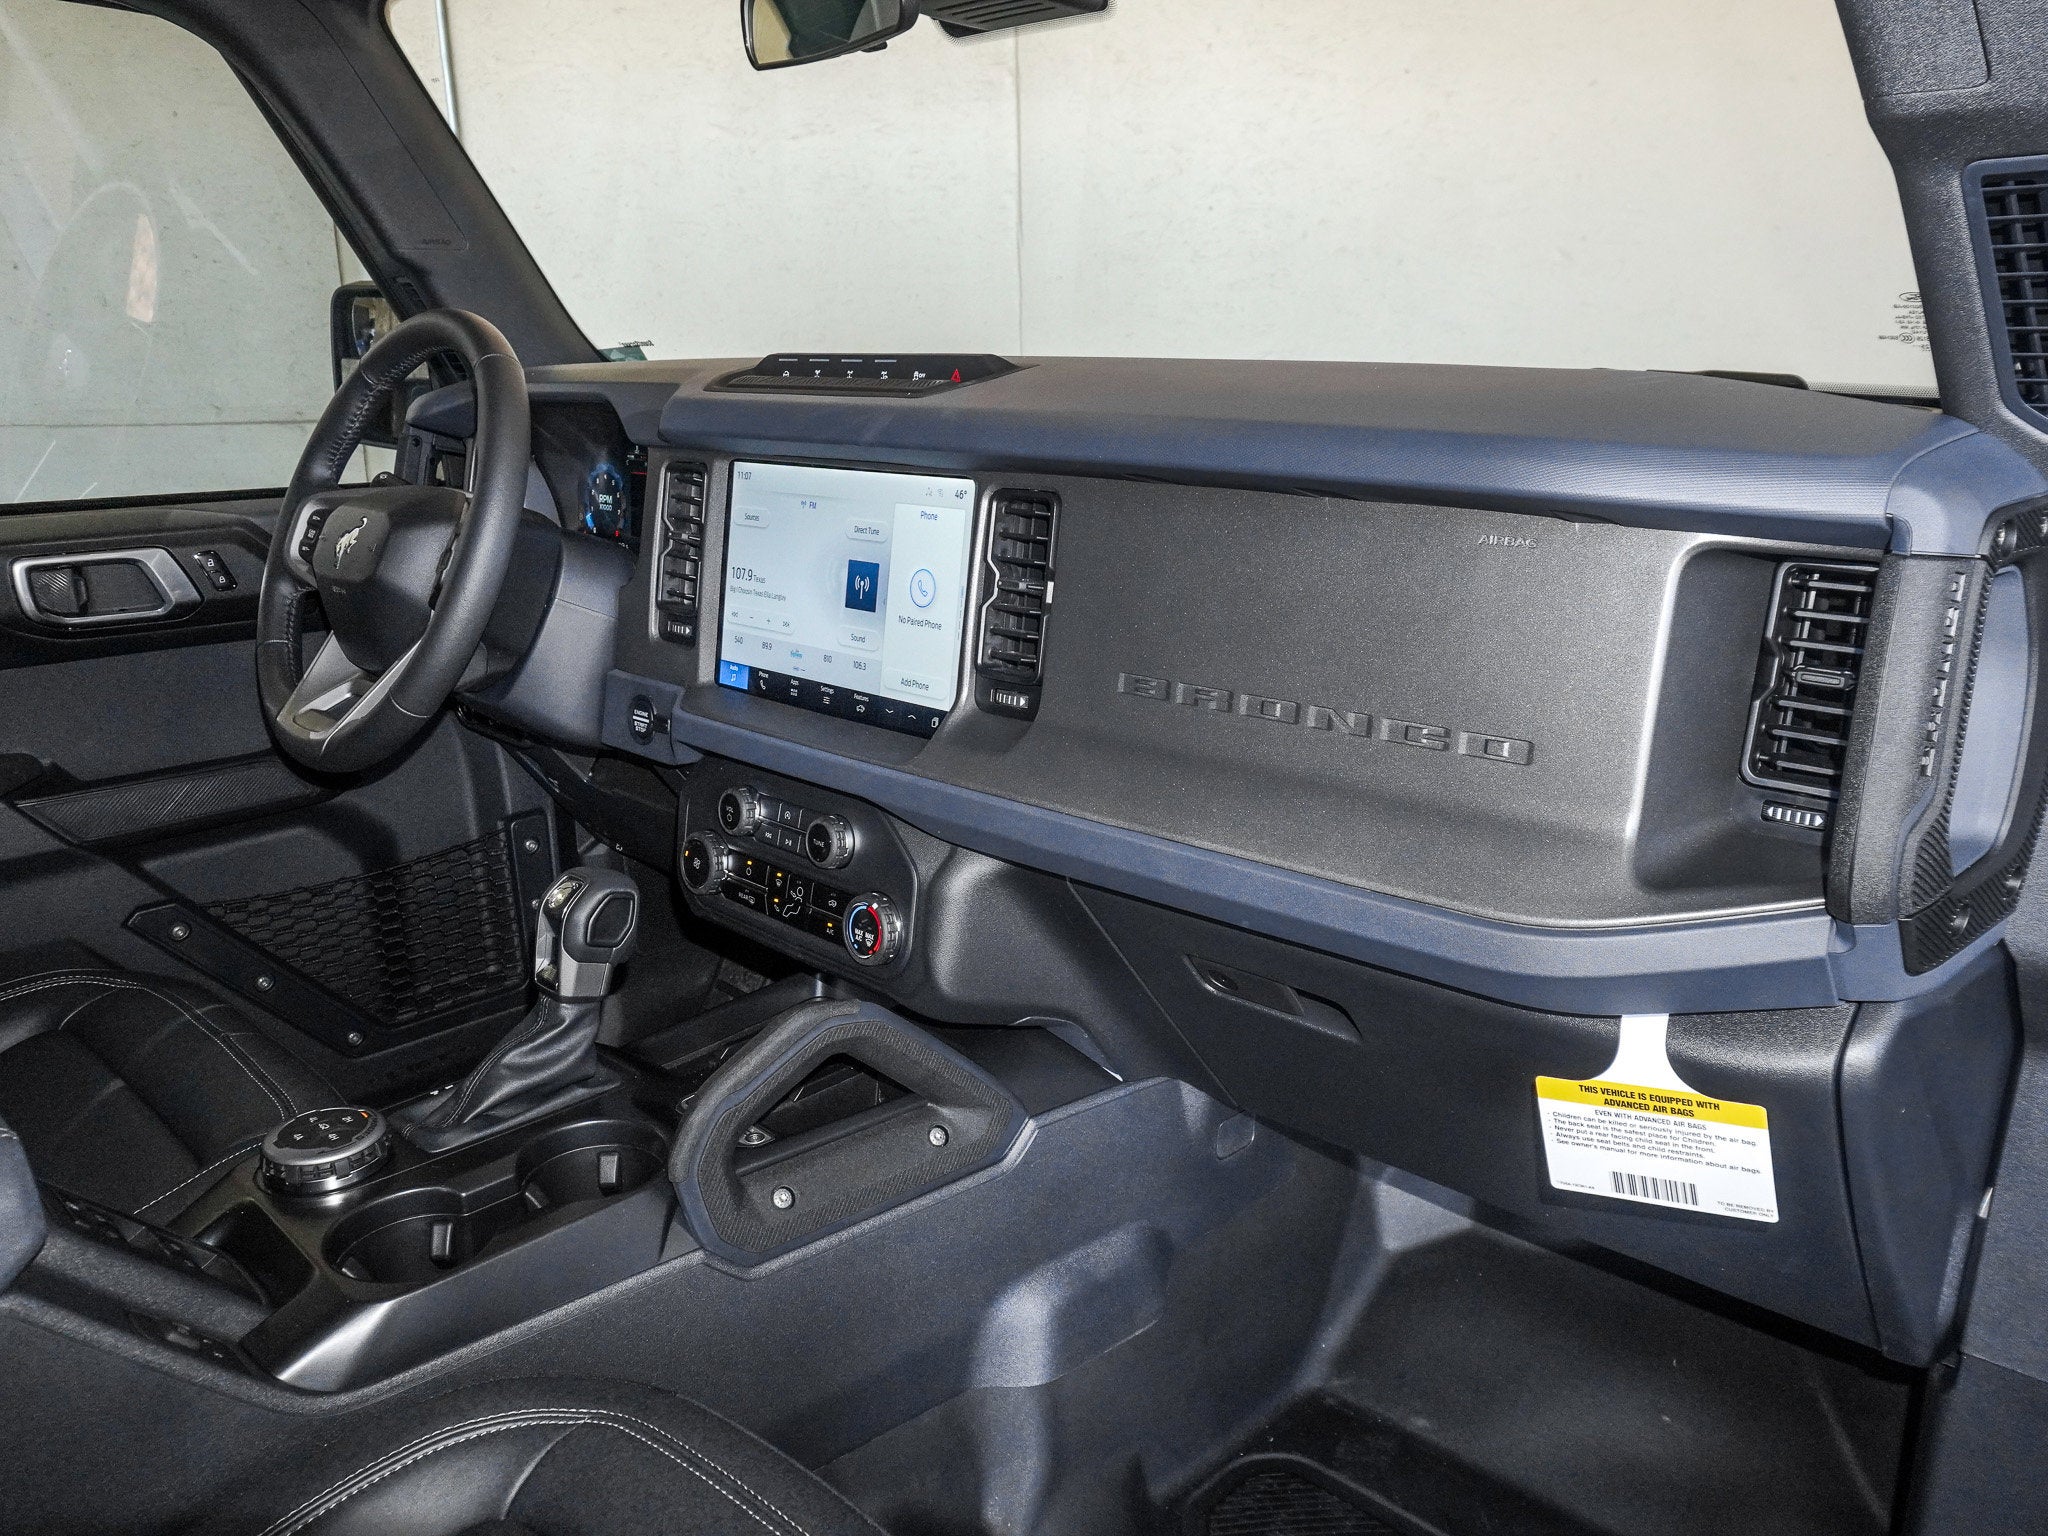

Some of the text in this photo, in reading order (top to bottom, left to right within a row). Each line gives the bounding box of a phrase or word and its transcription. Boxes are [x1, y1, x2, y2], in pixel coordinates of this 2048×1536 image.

[738, 471, 752, 480] 11:07
[599, 494, 612, 504] RPM
[808, 502, 817, 510] FM
[920, 510, 938, 520] Phone
[854, 526, 880, 536] Direct Tune
[1478, 534, 1538, 548] AIRBAG
[732, 566, 766, 584] 107.9 Texas
[898, 616, 942, 630] No Paired Phone
[851, 634, 866, 643] Sound
[734, 636, 744, 644] 540
[762, 642, 772, 650] 89.9
[823, 654, 832, 663] 810
[900, 678, 929, 691] Add Phone
[634, 709, 648, 718] ENGINE
[1117, 672, 1535, 766] BRONCO
[813, 838, 825, 848] TUNE
[1578, 1084, 1720, 1110] THIS VEHICLE IS EQUIPPED WITH
[1604, 1098, 1695, 1117] ADVANCED AIR BAGS
[1552, 1112, 1582, 1120] Children
[1608, 1120, 1628, 1128] killed
[1639, 1124, 1673, 1135] seriously
[1675, 1129, 1702, 1138] injured
[1704, 1132, 1713, 1141] by
[1594, 1109, 1612, 1117] EVEN
[1614, 1111, 1632, 1120] WITH
[1634, 1114, 1671, 1126] ADVANCED
[1688, 1122, 1707, 1131] BAGS
[1554, 1125, 1574, 1134] Never
[1611, 1133, 1633, 1142] facing
[1556, 1132, 1580, 1141] Always
[1624, 1128, 1646, 1136] safest
[1648, 1130, 1668, 1140] place
[1571, 1141, 1598, 1149] owner's
[1600, 1145, 1626, 1154] manual
[1660, 1153, 1703, 1165] information
[1706, 1161, 1727, 1169] about
[1736, 1204, 1765, 1212] REMOVED
